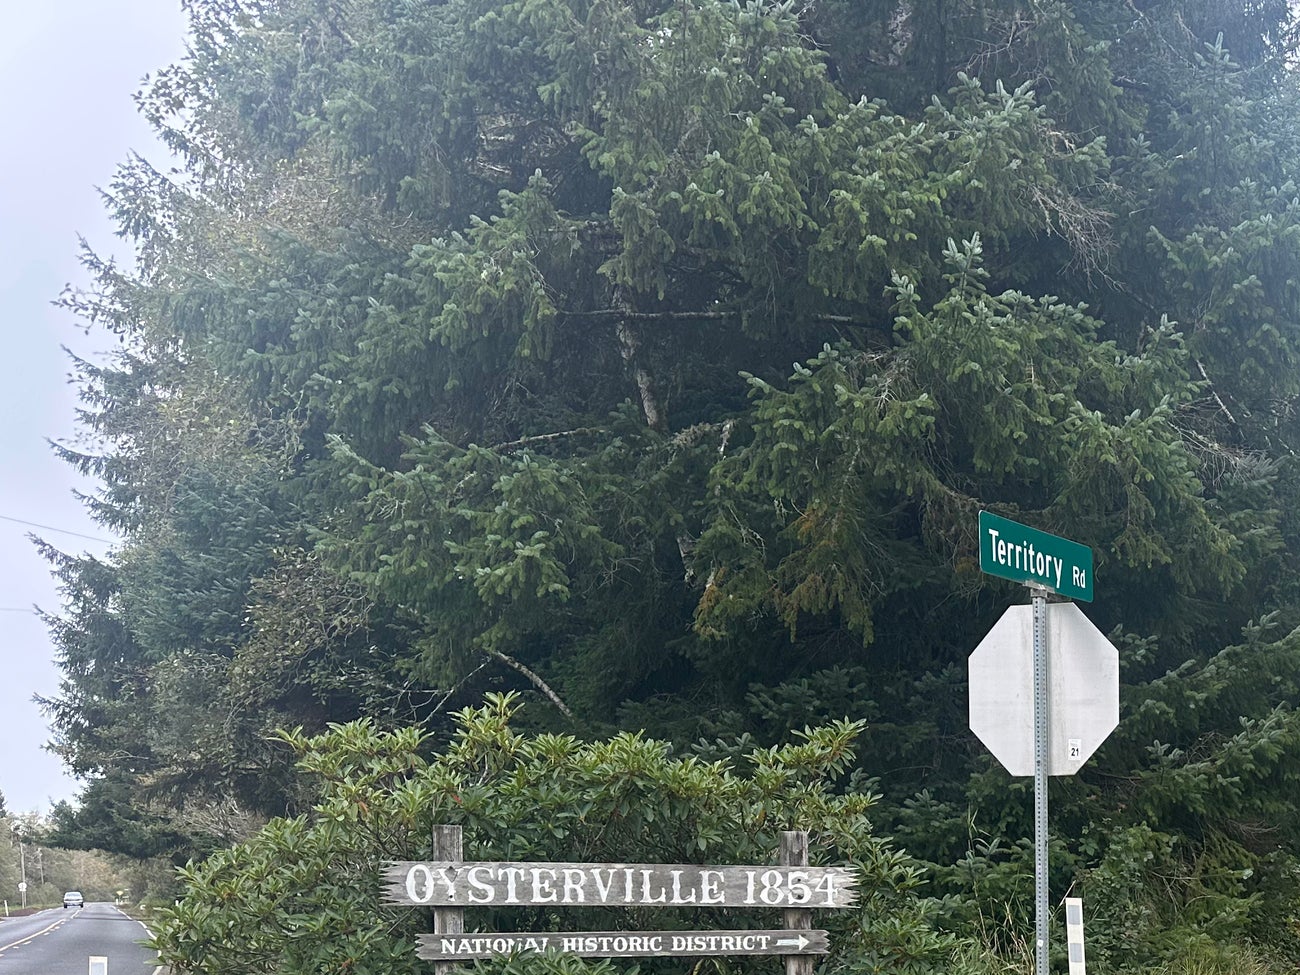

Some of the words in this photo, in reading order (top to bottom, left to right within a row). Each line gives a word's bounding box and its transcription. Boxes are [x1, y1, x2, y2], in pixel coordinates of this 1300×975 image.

[988, 528, 1063, 589] Territory
[1072, 565, 1086, 589] Rd
[1071, 747, 1079, 757] 21
[405, 864, 725, 904] OYSTERVILLE
[743, 869, 838, 905] 1854
[562, 936, 663, 953] HISTORIC
[671, 935, 771, 951] DISTRICT
